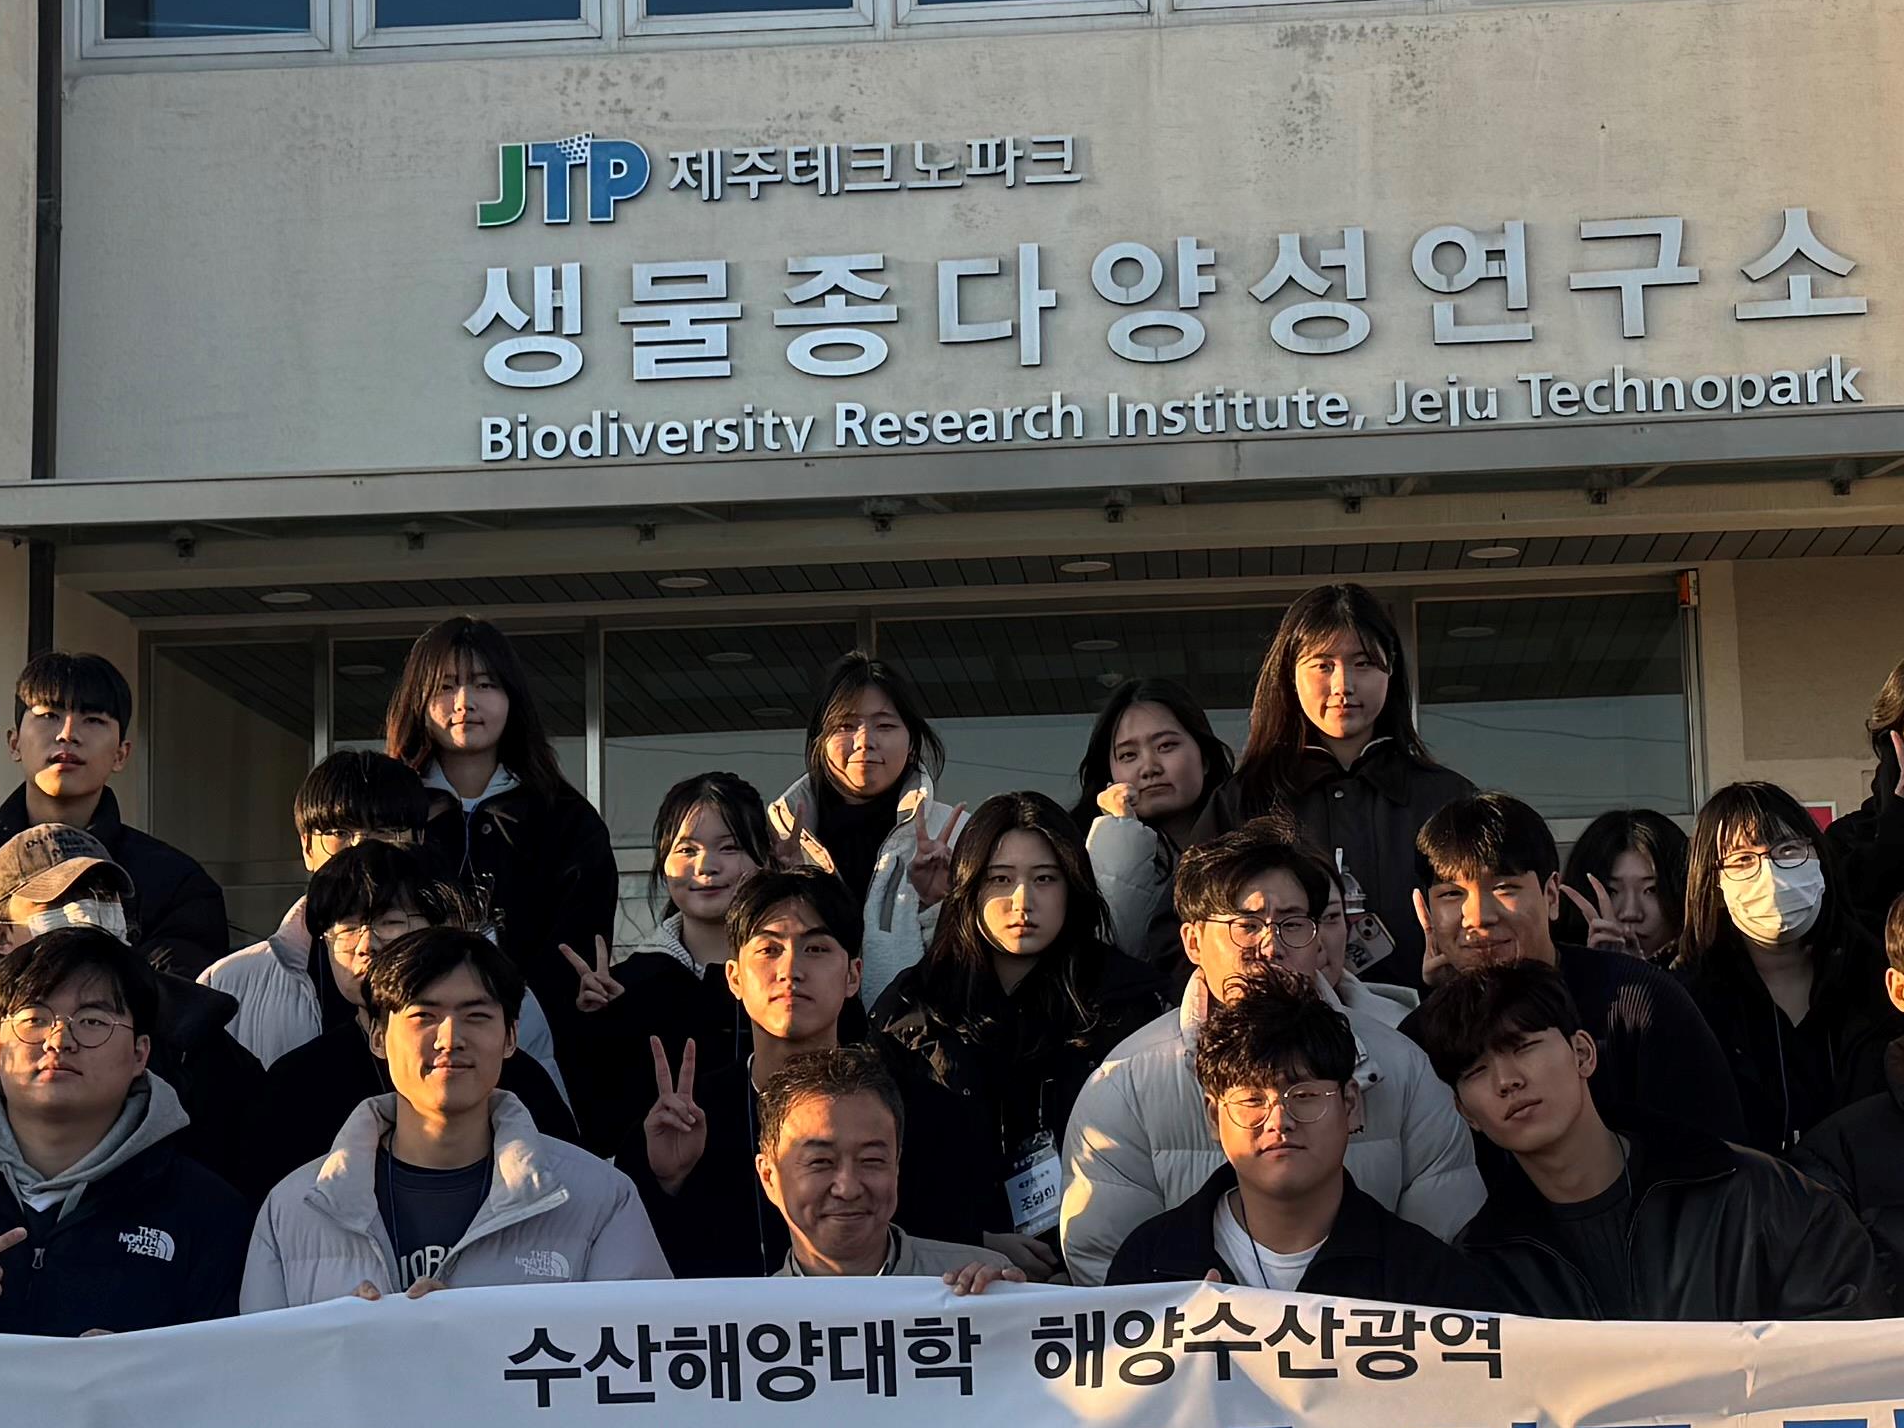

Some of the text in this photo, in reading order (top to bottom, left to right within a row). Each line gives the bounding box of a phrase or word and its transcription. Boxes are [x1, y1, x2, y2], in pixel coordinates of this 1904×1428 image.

[476, 132, 651, 227] JTP
[667, 134, 1084, 202] 제주테크노파크
[480, 353, 1865, 462] Biodiversity Research Institute, Jeju Technopark
[118, 1232, 158, 1247] NORTH
[138, 1225, 161, 1239] THE
[503, 1306, 1503, 1407] 수산해양대학 해양수산광역
